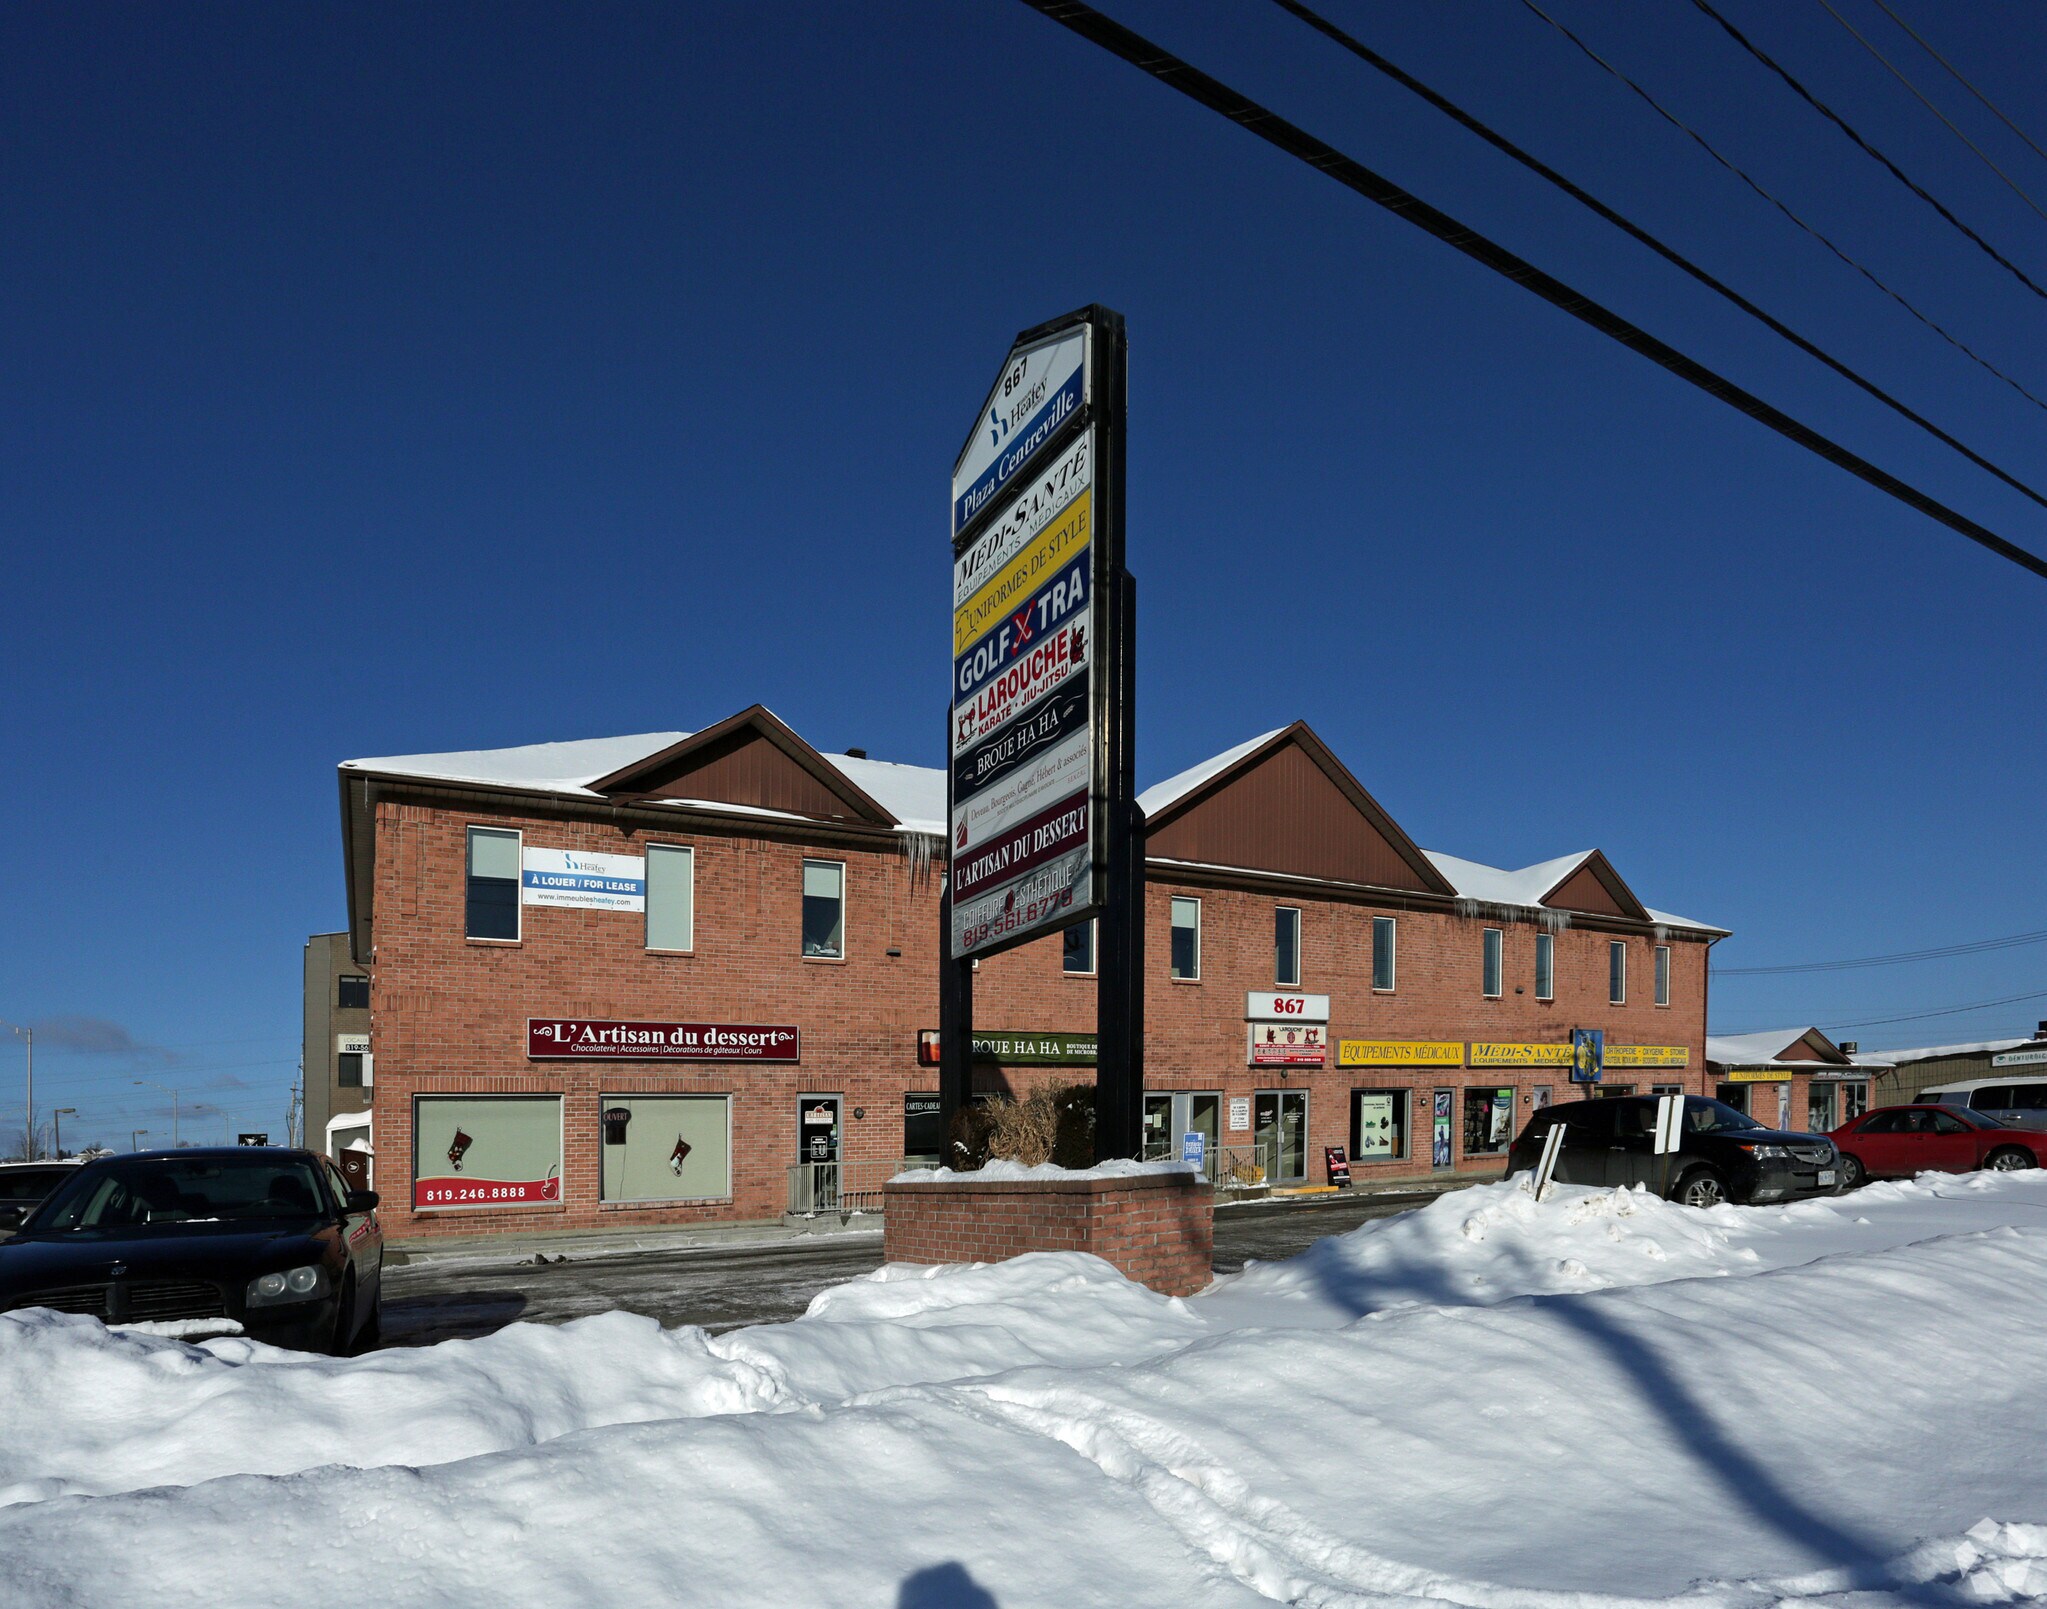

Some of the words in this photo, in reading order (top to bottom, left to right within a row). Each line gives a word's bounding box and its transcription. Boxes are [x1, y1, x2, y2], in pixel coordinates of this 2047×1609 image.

[1004, 357, 1028, 398] 867
[963, 477, 996, 522] Plaza
[998, 389, 1074, 482] Centreville
[969, 564, 1028, 629] UNIFORMES
[1030, 547, 1047, 576] DE
[1049, 510, 1087, 559] STYLE
[978, 628, 1068, 722] LAROUCHE
[978, 703, 1012, 737] KARATÉ
[1021, 665, 1069, 706] JIU-JITSU
[976, 738, 1015, 776] BROUE
[1017, 724, 1036, 746] HA
[1039, 708, 1059, 736] HA
[956, 844, 1009, 891] L'ARTISAN
[1013, 832, 1030, 863] DU
[1033, 804, 1087, 851] DESSERT
[532, 874, 539, 884] À
[542, 877, 576, 887] LOUER
[584, 879, 604, 889] FOR
[606, 881, 637, 892] LEASE
[537, 893, 631, 906] www.immeublesheafey.com
[963, 897, 1004, 930] COIFFURE
[963, 886, 1073, 948] 819.561.6779
[1273, 998, 1305, 1014] 867
[552, 1023, 665, 1044] L'Artisan
[670, 1027, 699, 1045] du
[703, 1027, 778, 1046] dessert
[570, 1043, 617, 1053] Chocolaterie
[620, 1045, 659, 1053] Accessoires
[663, 1045, 704, 1054] Décorations
[704, 1046, 713, 1054] de
[744, 1046, 762, 1054] Cours
[972, 1040, 1010, 1054] ROUE
[1014, 1041, 1036, 1054] HA
[1039, 1041, 1061, 1055] HA
[1343, 1042, 1411, 1061] ÉQUIPEMENTS
[1413, 1044, 1460, 1059] MÉDICAUX
[603, 1112, 627, 1121] OUVERT
[426, 1187, 525, 1201] 819.246.8888
